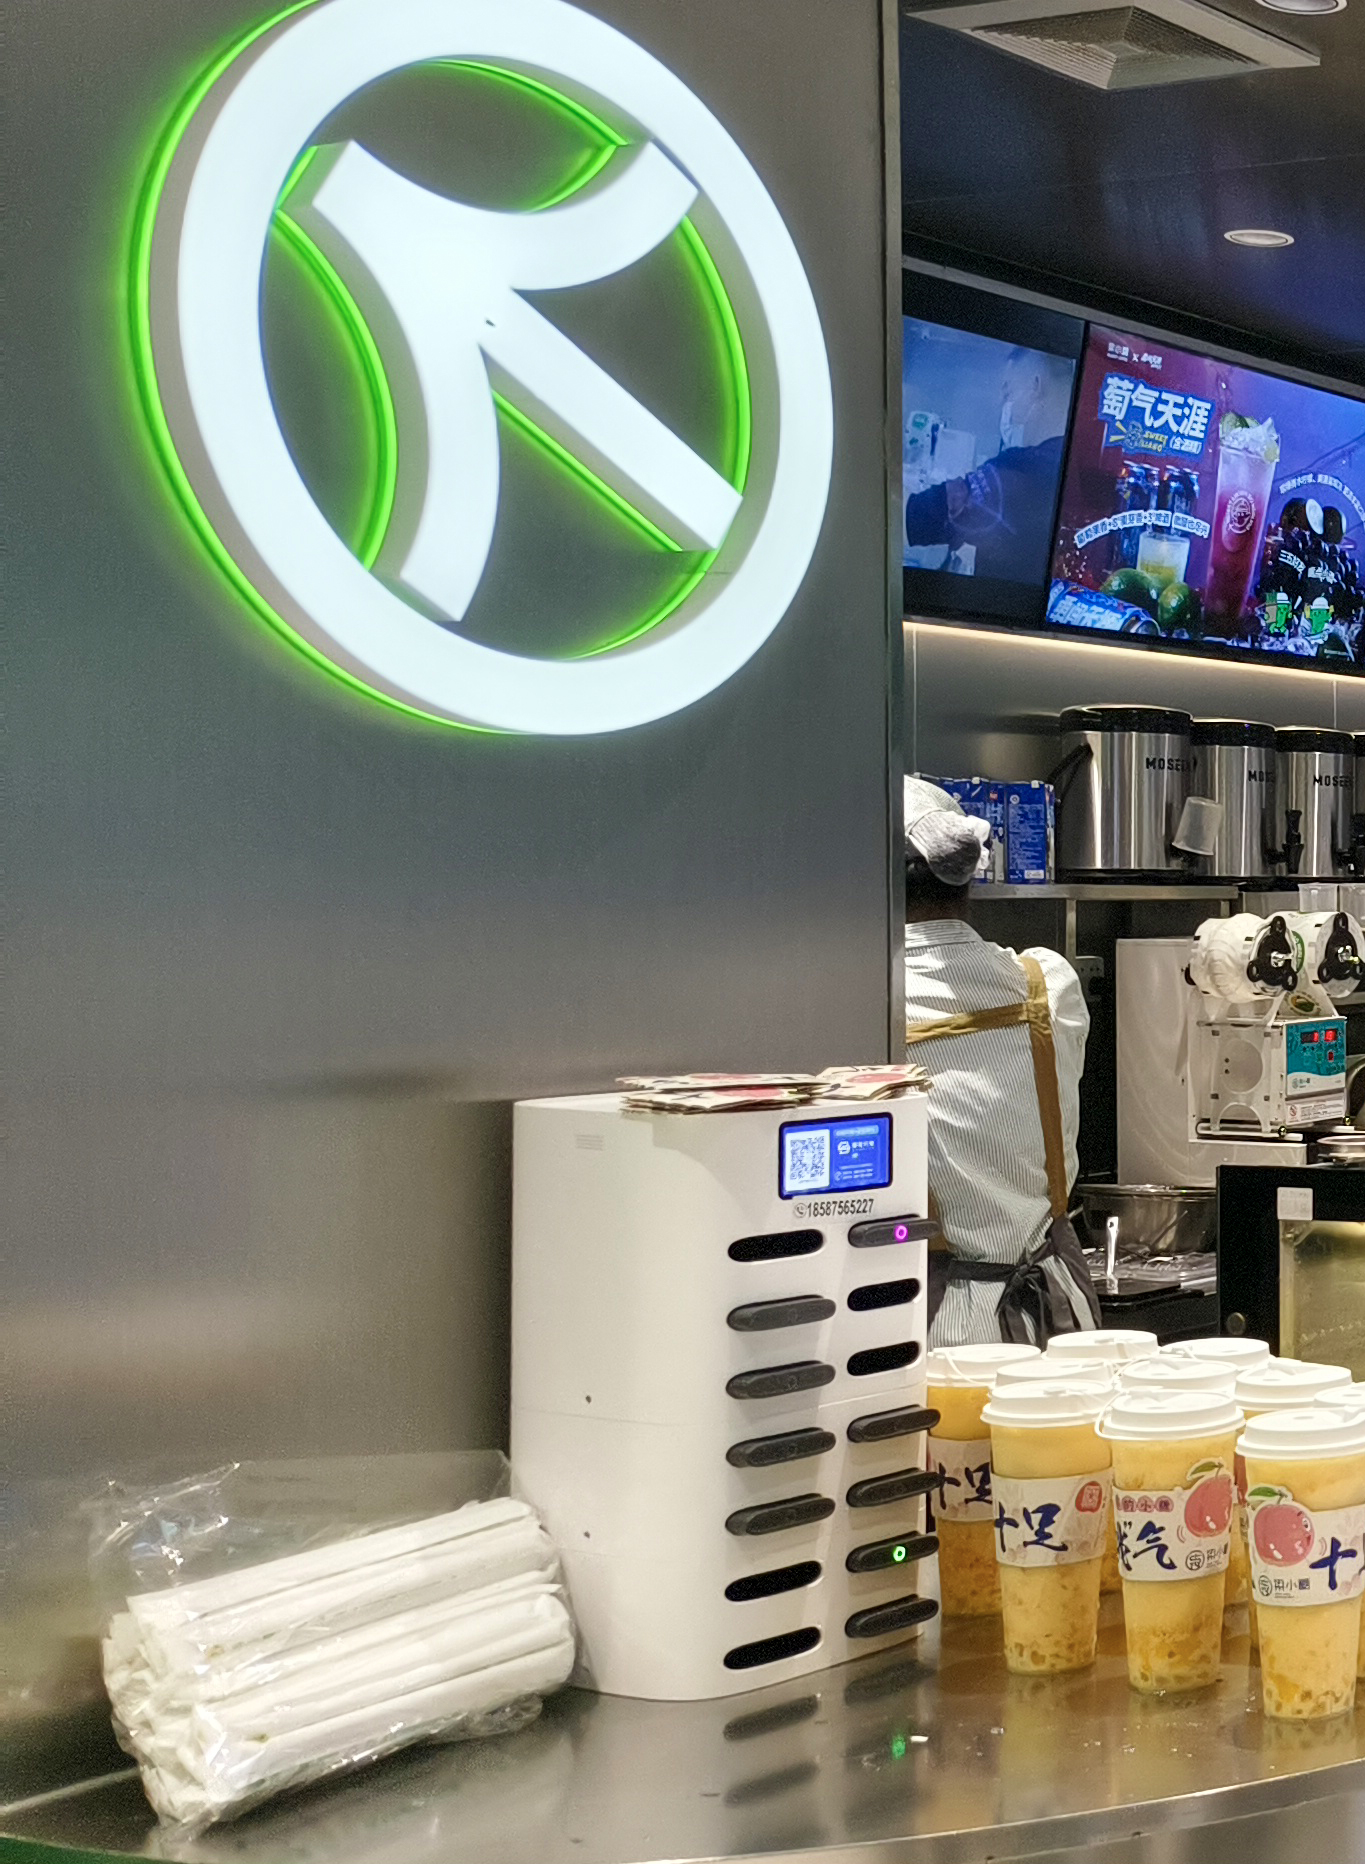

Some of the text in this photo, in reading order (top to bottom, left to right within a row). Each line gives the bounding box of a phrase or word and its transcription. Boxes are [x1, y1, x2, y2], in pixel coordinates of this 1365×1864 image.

[1102, 376, 1212, 439] 萄气天涯
[807, 1199, 875, 1218] 18587565227
